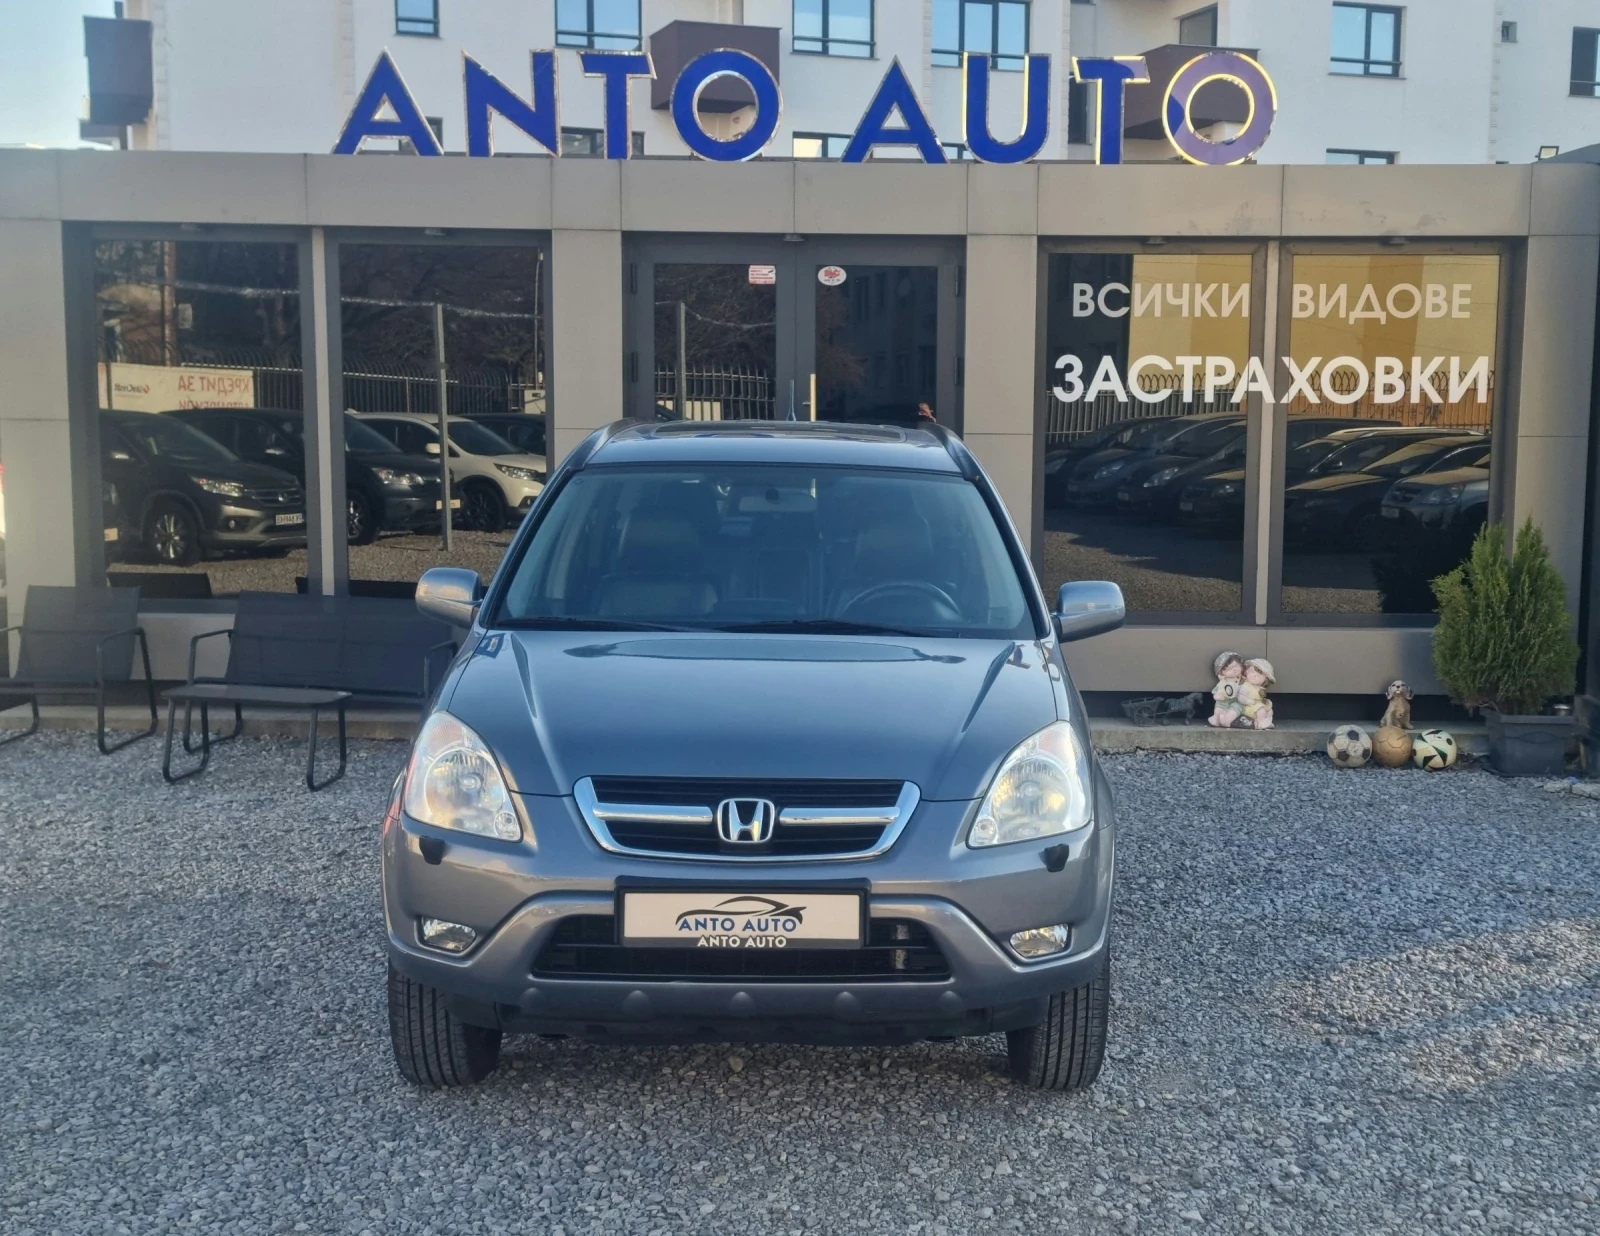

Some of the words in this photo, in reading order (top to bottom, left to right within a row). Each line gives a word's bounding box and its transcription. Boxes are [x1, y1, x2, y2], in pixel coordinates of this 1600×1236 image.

[331, 46, 783, 162] ANTO
[841, 50, 1278, 166] AUTO
[1072, 282, 1250, 318] ВСИЧКИ
[1292, 282, 1472, 325] ВИДОВЕ
[1053, 354, 1489, 404] ЗАСТРАХОВКИ
[679, 917, 735, 932] ANTO
[742, 918, 797, 932] AUTO
[697, 935, 740, 947] ANTO
[745, 936, 787, 948] AUTO
